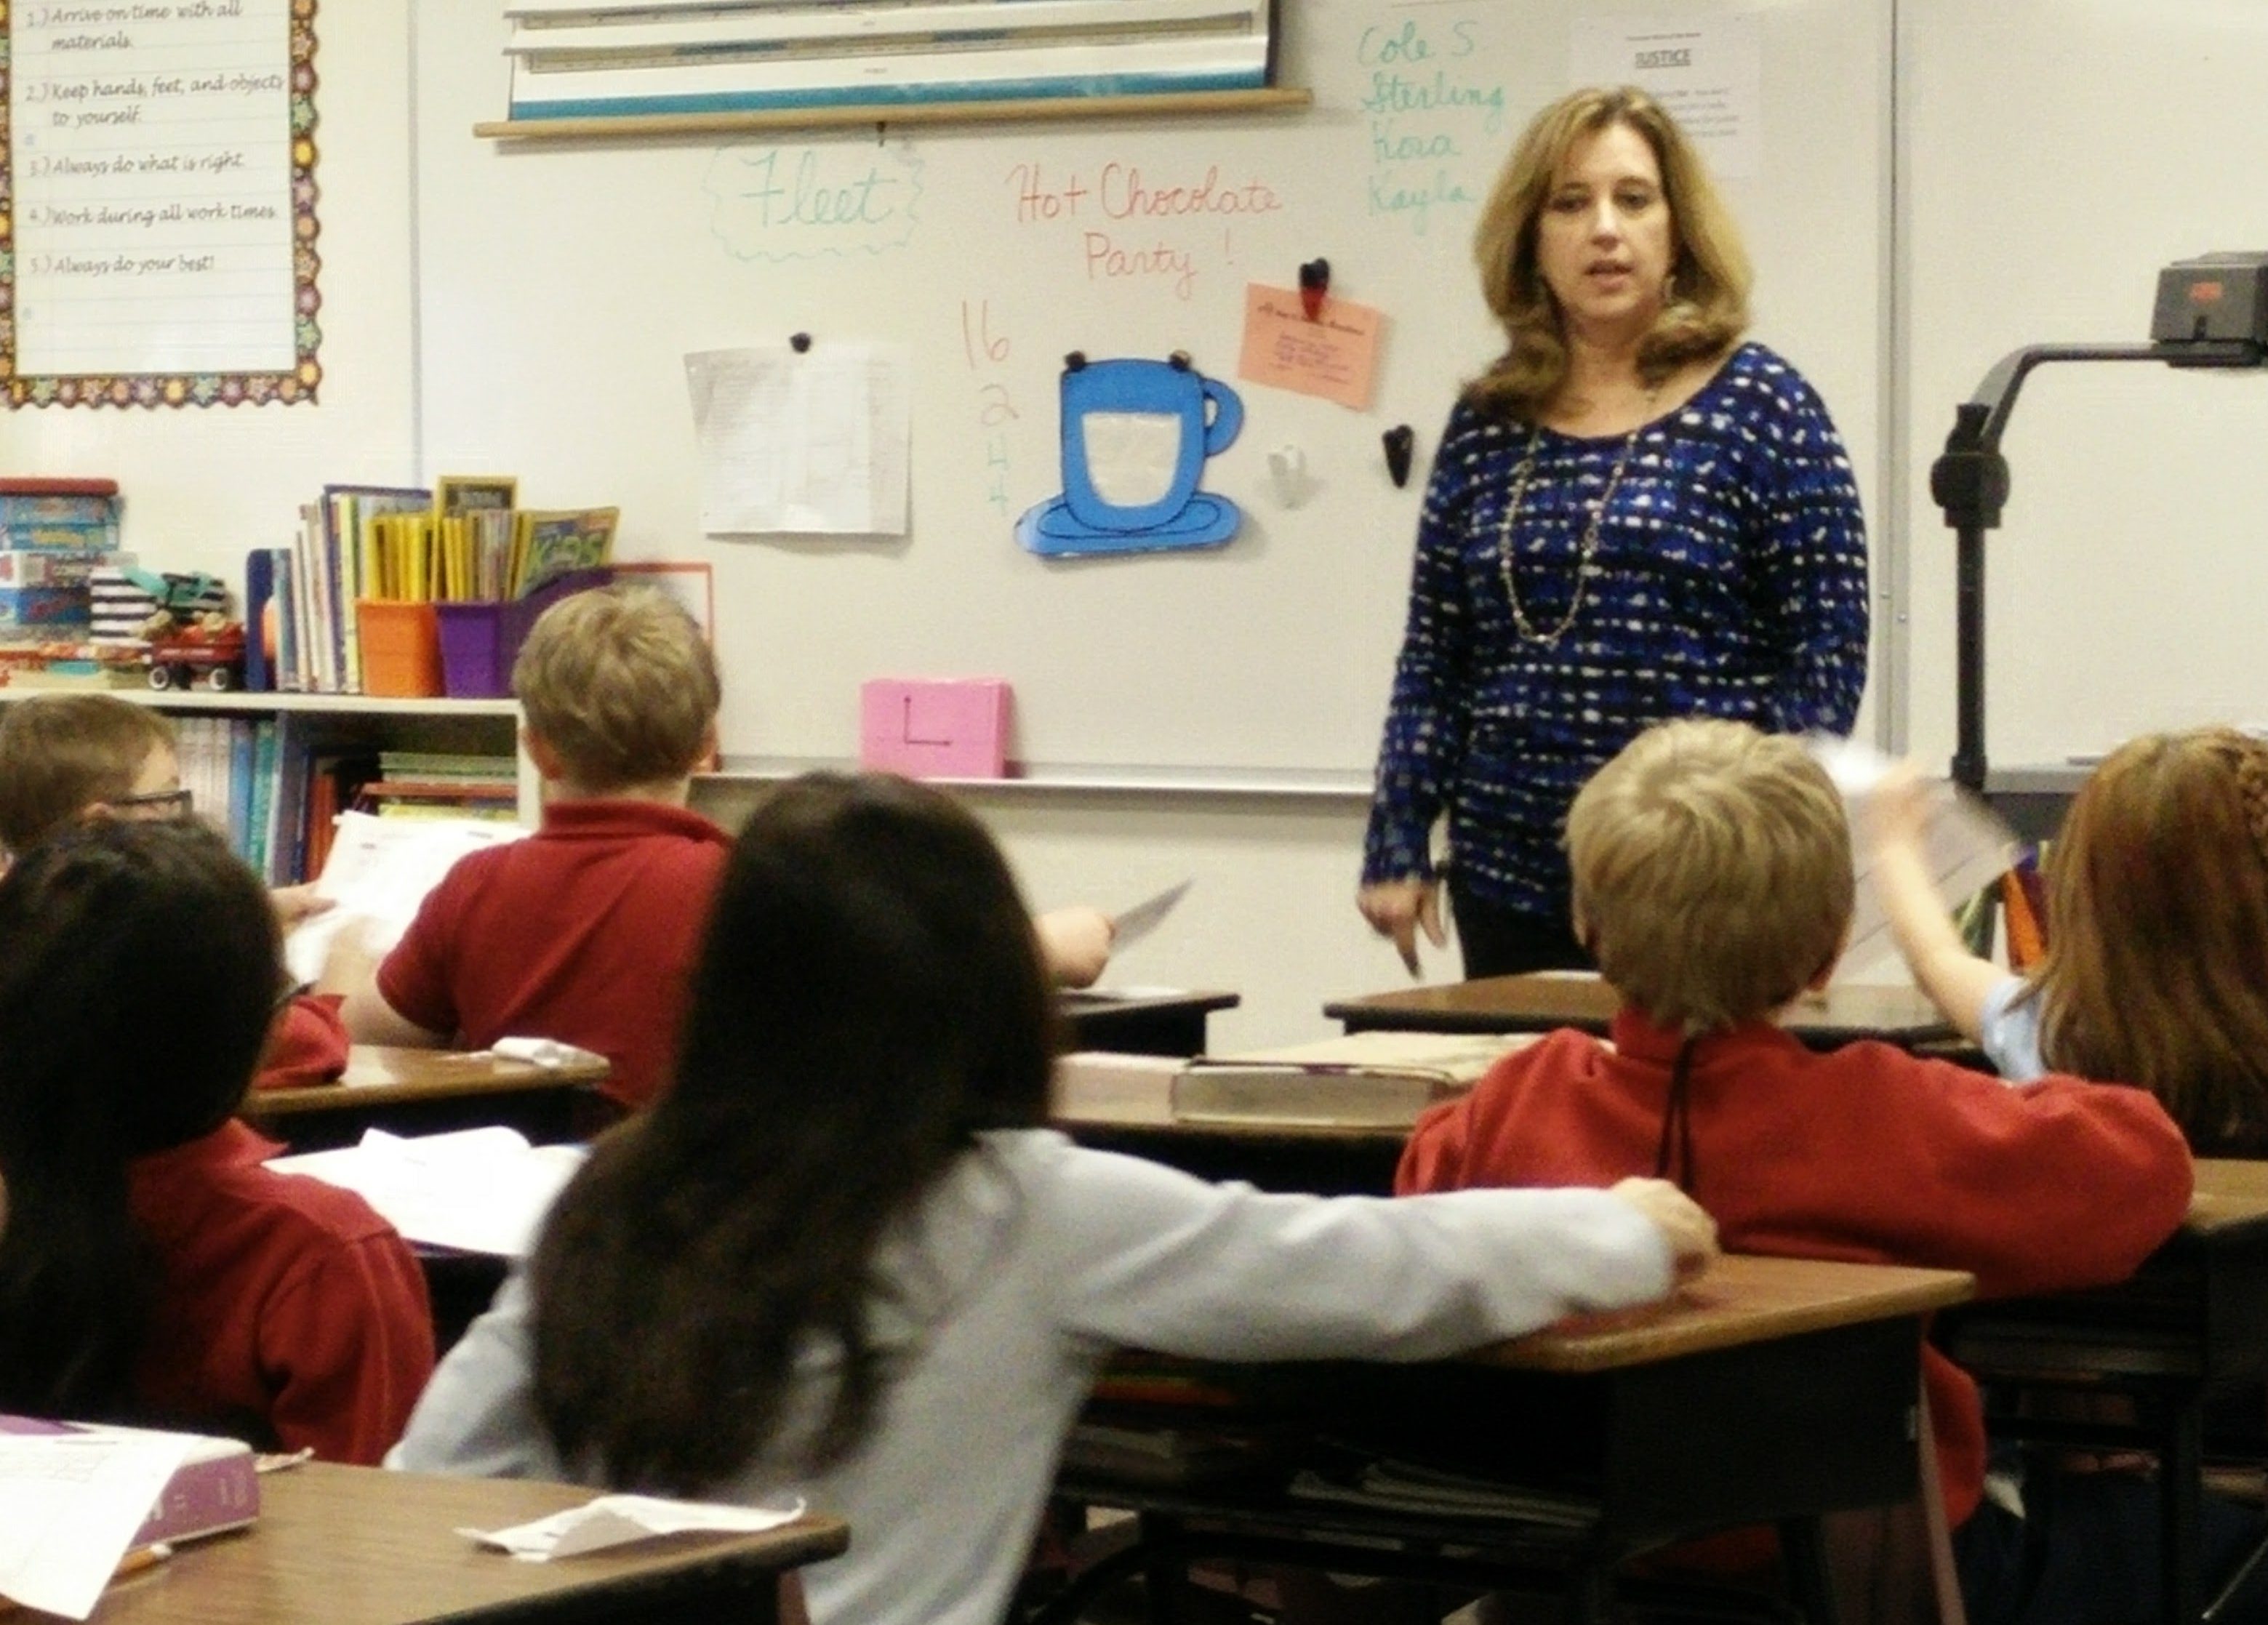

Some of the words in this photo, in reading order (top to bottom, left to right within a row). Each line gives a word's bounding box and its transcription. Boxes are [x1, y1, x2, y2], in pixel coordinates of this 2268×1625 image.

[52, 8, 103, 23] Arrive
[106, 9, 129, 21] on
[132, 4, 171, 19] time
[177, 0, 214, 18] with
[217, 0, 242, 17] all
[1357, 20, 1436, 67] Cole
[1451, 19, 1479, 57] S
[1635, 48, 1692, 68] JUSTICE
[52, 83, 89, 104] Keep
[151, 76, 185, 97] feet,
[191, 73, 227, 92] and
[230, 73, 284, 97] objects
[1358, 71, 1506, 135] Sterling
[53, 111, 70, 127] to
[53, 156, 109, 178] Always
[113, 154, 135, 174] do
[138, 153, 178, 172] what
[183, 154, 196, 172] is
[740, 149, 897, 228] Fleet
[53, 206, 93, 227] Work
[97, 206, 157, 228] during
[159, 203, 182, 221] all
[186, 201, 228, 220] work
[1006, 162, 1089, 222] Hot
[1100, 161, 1283, 220] Chocolate
[1367, 169, 1478, 236] Kayla
[55, 255, 110, 278] Always
[113, 254, 135, 273] do
[137, 257, 176, 276] your
[1084, 230, 1198, 301] Party
[961, 300, 1010, 371] 16
[979, 382, 1020, 428] 2
